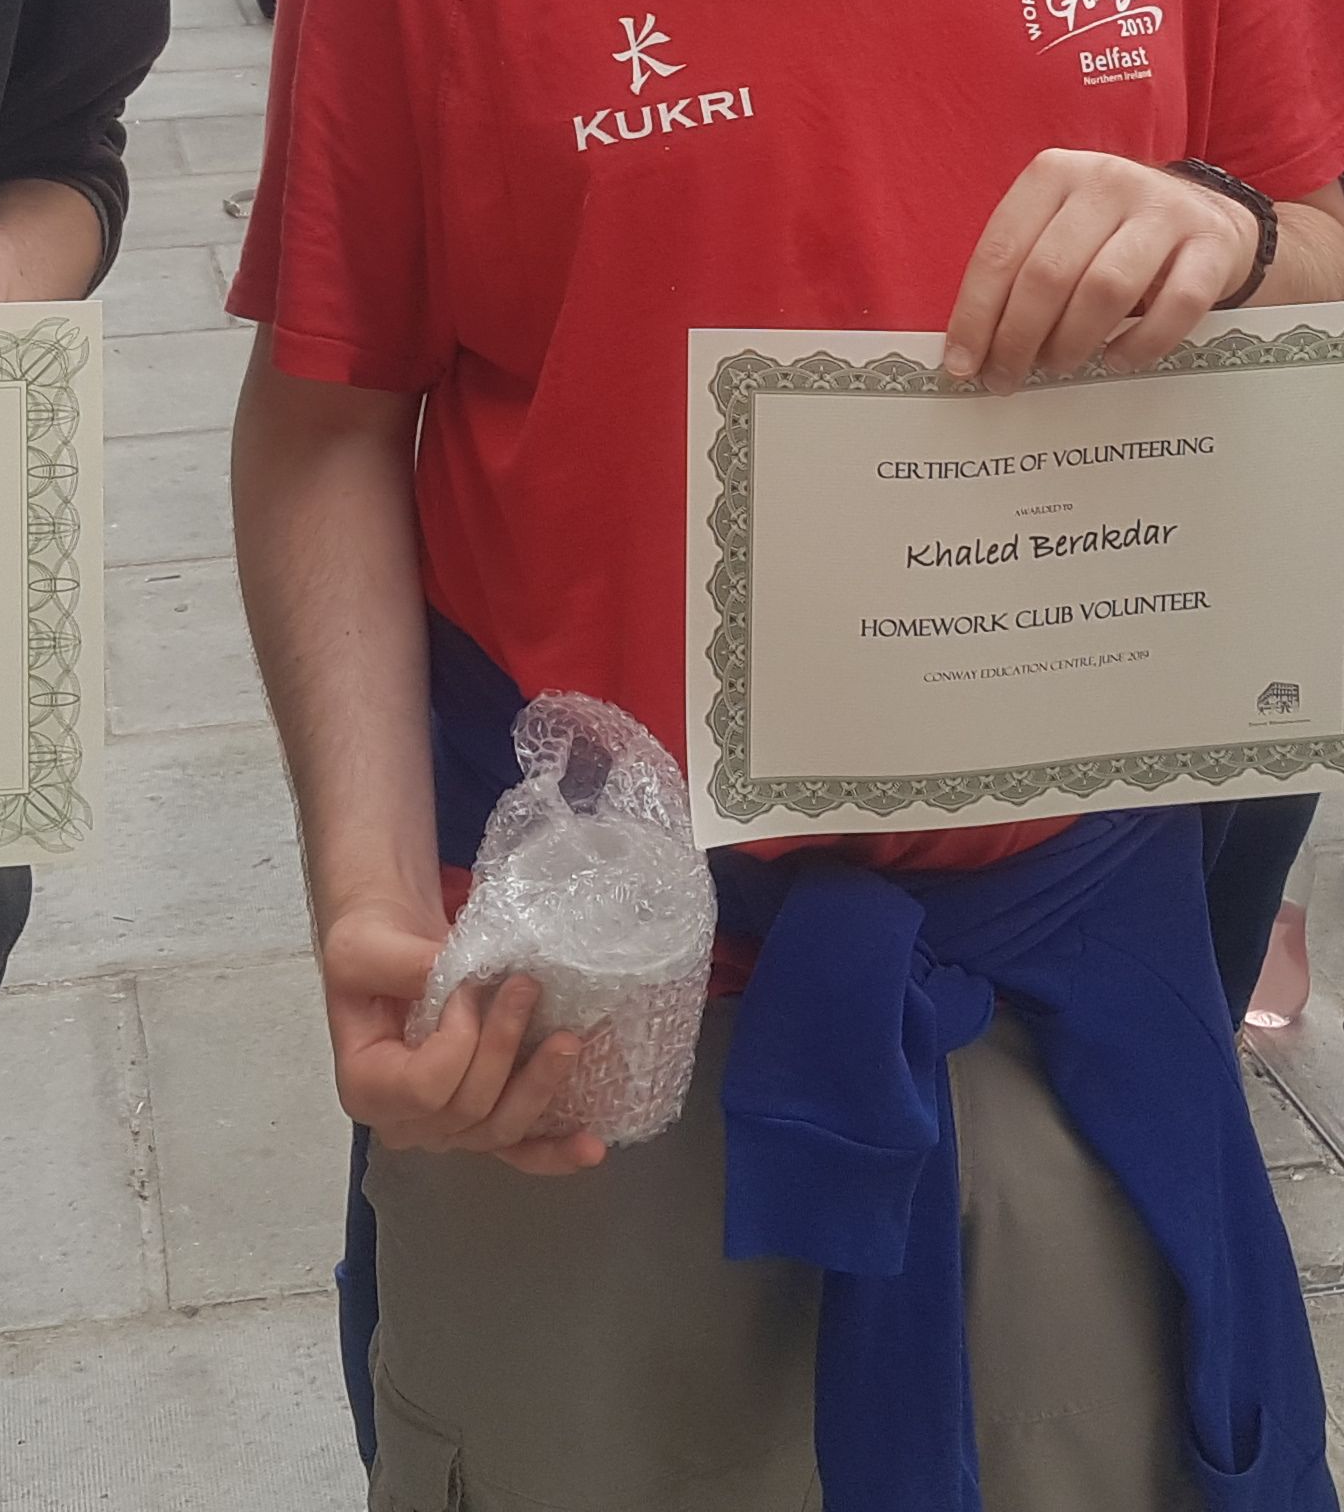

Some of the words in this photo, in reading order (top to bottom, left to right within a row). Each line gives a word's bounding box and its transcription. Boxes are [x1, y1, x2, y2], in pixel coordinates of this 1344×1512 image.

[1117, 16, 1154, 37] 2013
[1079, 46, 1149, 73] Belfast
[1083, 72, 1123, 86] Northern
[1124, 69, 1152, 82] Ireland
[573, 87, 754, 152] KUKRI
[877, 456, 1016, 480] CERTIFICATE
[1020, 452, 1048, 472] OF
[1053, 436, 1214, 468] VOLUNTEERING
[907, 533, 1019, 568] Khaled
[1029, 518, 1178, 559] Berakdar
[861, 613, 1009, 638] HOMEWORK
[1015, 605, 1073, 629] CLUB
[1079, 591, 1211, 621] VOLUNTEER
[923, 669, 977, 683] CONWAY
[980, 661, 1048, 679] EDUCATION
[1050, 656, 1096, 671] CENTRE,
[1098, 651, 1124, 666] JUNE
[1127, 649, 1149, 662] 2019
